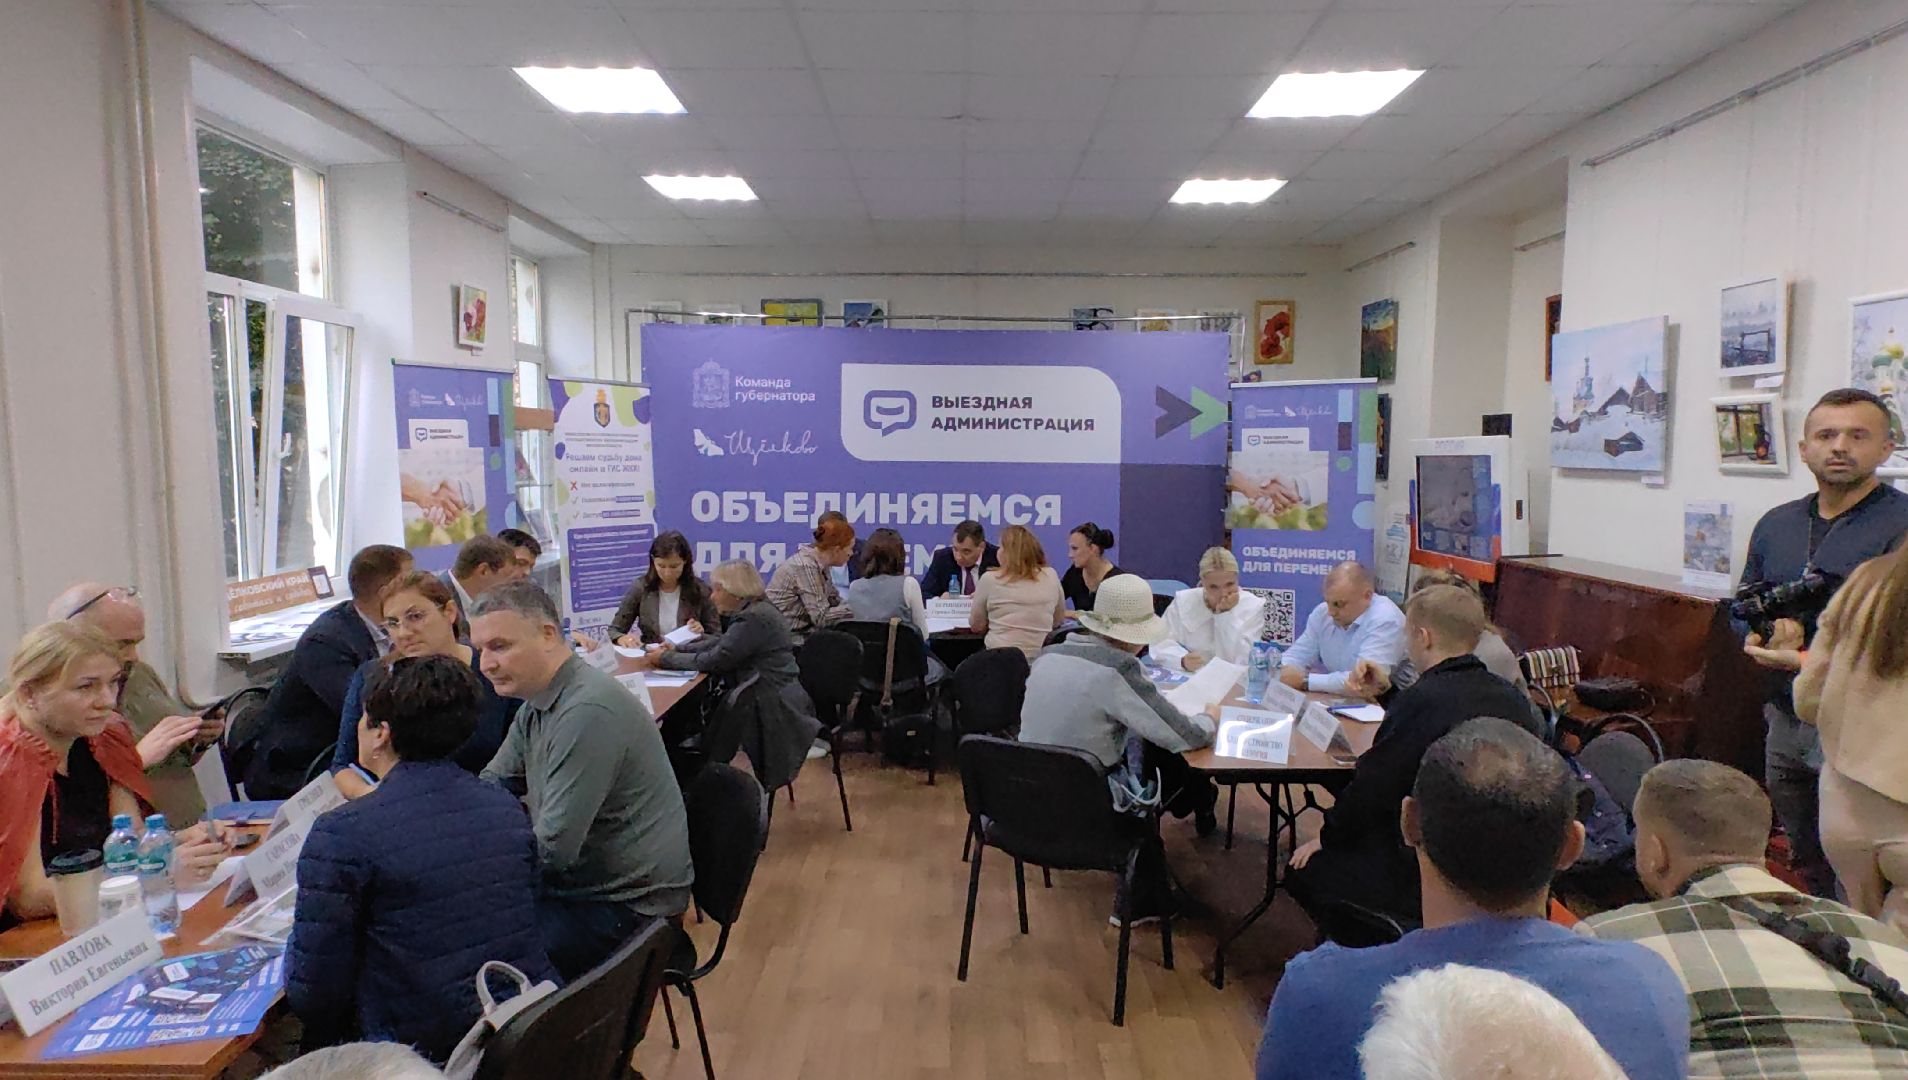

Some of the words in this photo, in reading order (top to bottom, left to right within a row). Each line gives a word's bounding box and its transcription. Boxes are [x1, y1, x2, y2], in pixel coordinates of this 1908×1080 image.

[735, 376, 791, 389] Команда
[735, 390, 816, 404] губернатора
[931, 396, 1033, 411] ВЫЕЗДНАЯ
[931, 417, 1095, 433] АДМИНИСТРАЦИЯ
[691, 490, 1062, 527] ОБЪЕДИНЯЕМСЯ
[1242, 546, 1356, 561] ОБЪЕДИНЯЕМСЯ
[1242, 561, 1272, 573] ДЛЯ
[1273, 562, 1333, 576] ПЕРЕМЕ
[49, 934, 112, 976] ПАВЛОВА
[29, 975, 89, 1016] Виктория
[86, 942, 149, 982] Евгеньевна
